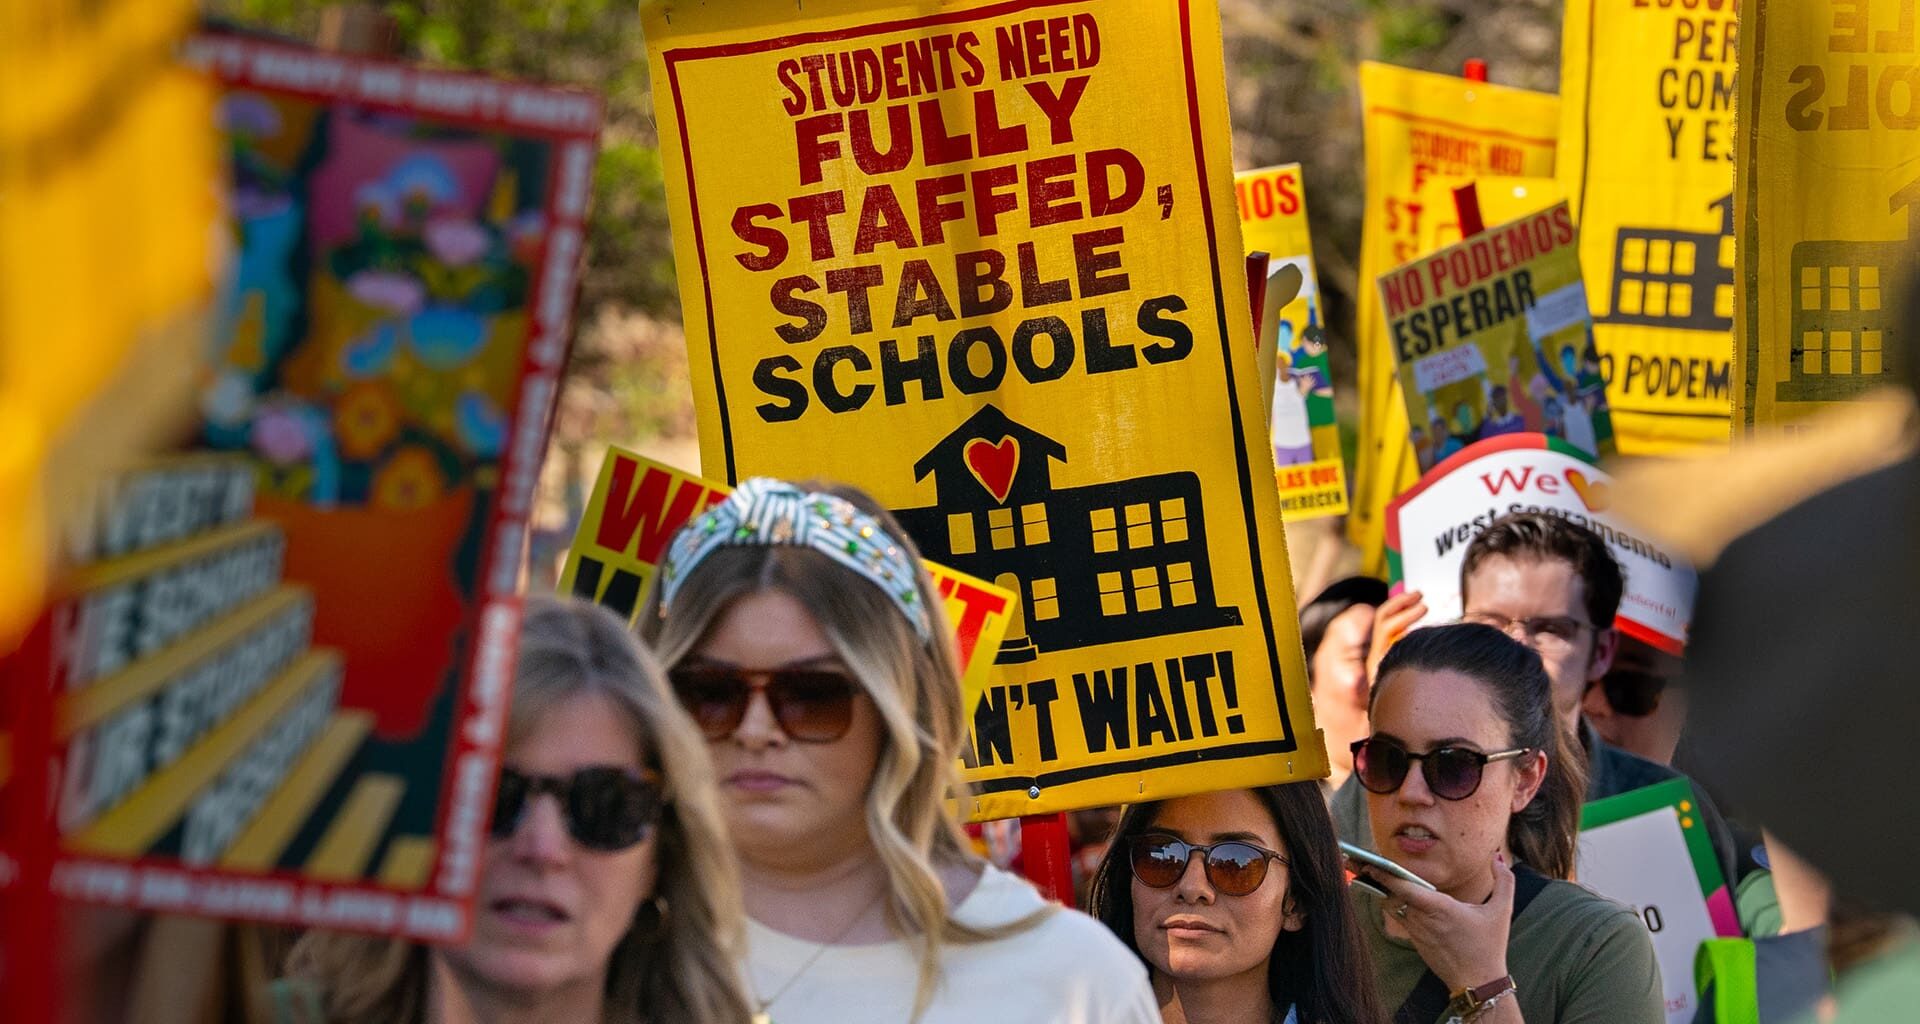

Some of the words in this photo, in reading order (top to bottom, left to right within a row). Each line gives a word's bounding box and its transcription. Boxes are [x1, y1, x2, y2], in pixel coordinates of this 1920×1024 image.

[776, 31, 984, 117] STUDENTS
[996, 13, 1100, 81] NEED
[795, 75, 1090, 186] FULLY
[731, 147, 1174, 272] STAFFED,
[1384, 268, 1425, 316] NO
[1428, 205, 1575, 297] PODEMOS
[770, 227, 1131, 345] STABLE
[1393, 268, 1537, 363] ESPERAR
[752, 295, 1193, 423] SCHOOLS
[596, 455, 729, 566] W
[1481, 466, 1560, 497] We
[1072, 651, 1245, 754] WAIT!
